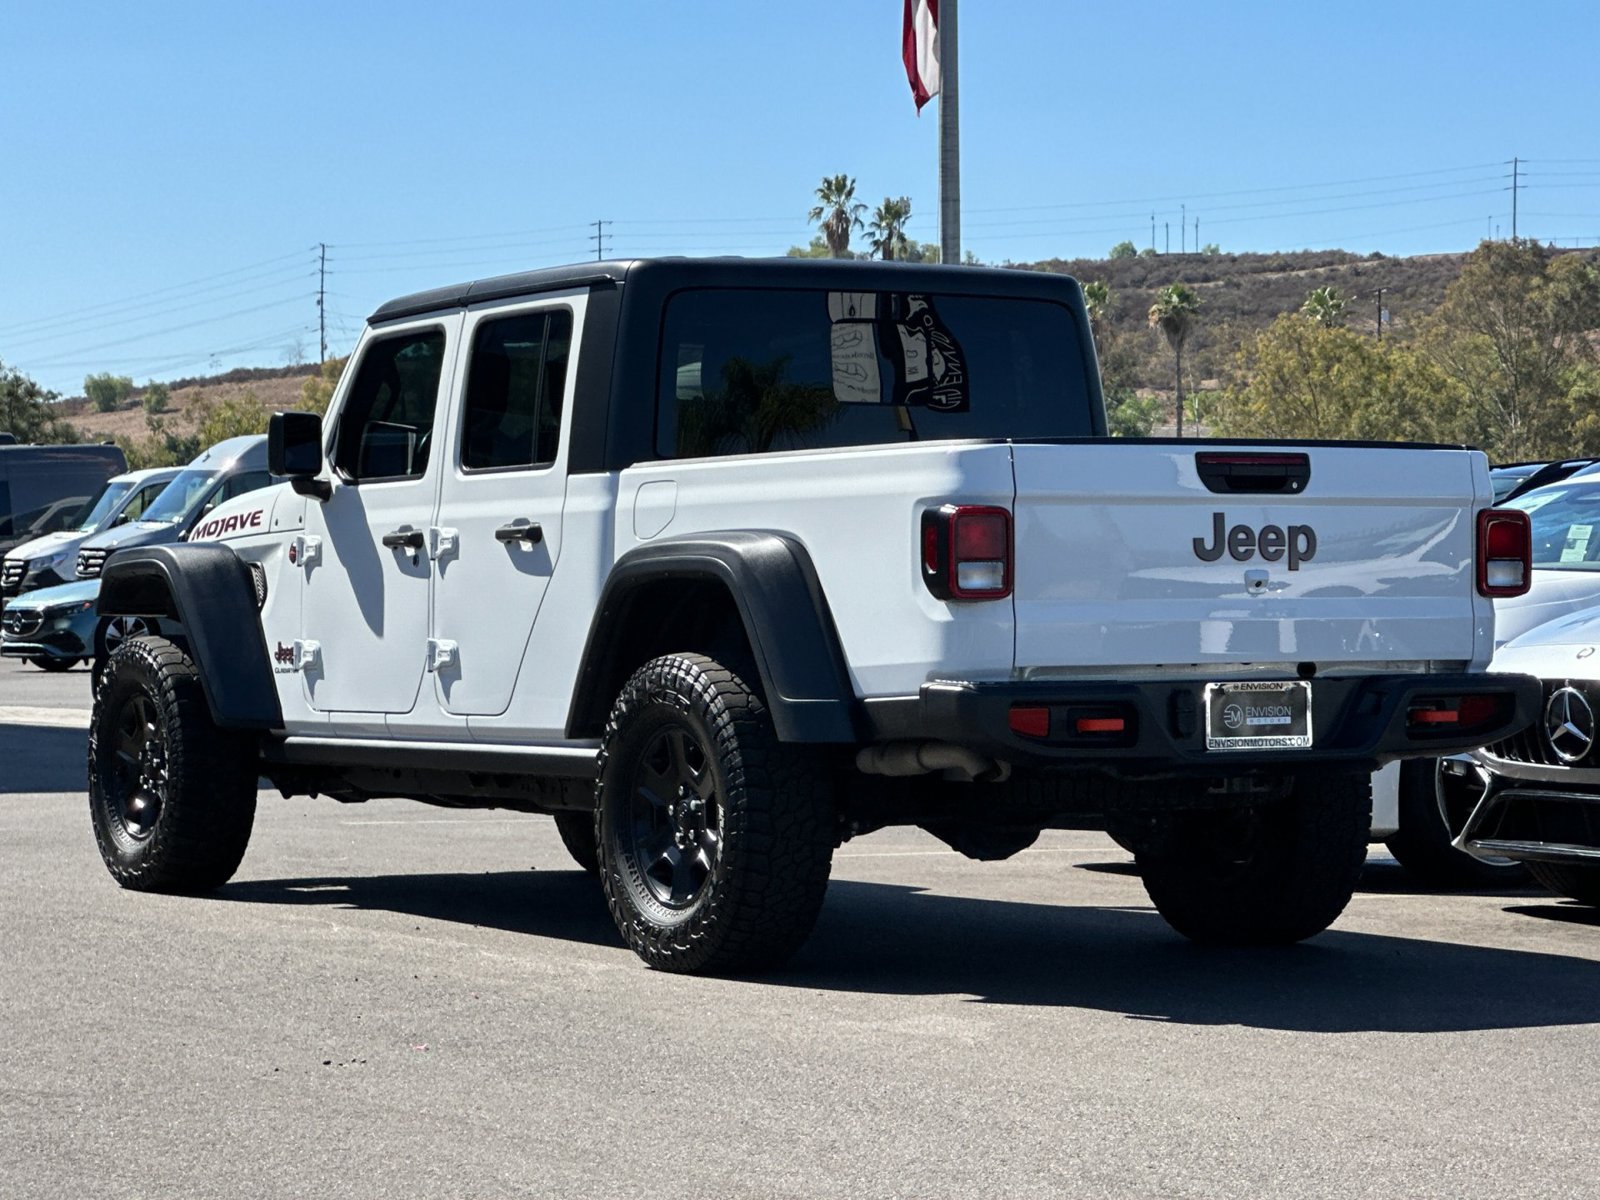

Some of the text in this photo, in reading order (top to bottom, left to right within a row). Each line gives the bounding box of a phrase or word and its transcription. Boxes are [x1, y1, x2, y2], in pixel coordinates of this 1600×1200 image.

[191, 509, 264, 541] MOJAVE
[1192, 512, 1317, 571] Jeep
[1240, 682, 1284, 690] ENVISION
[1246, 706, 1292, 718] ENVISION
[1208, 737, 1310, 748] ENVISIONMOTORS.COM
